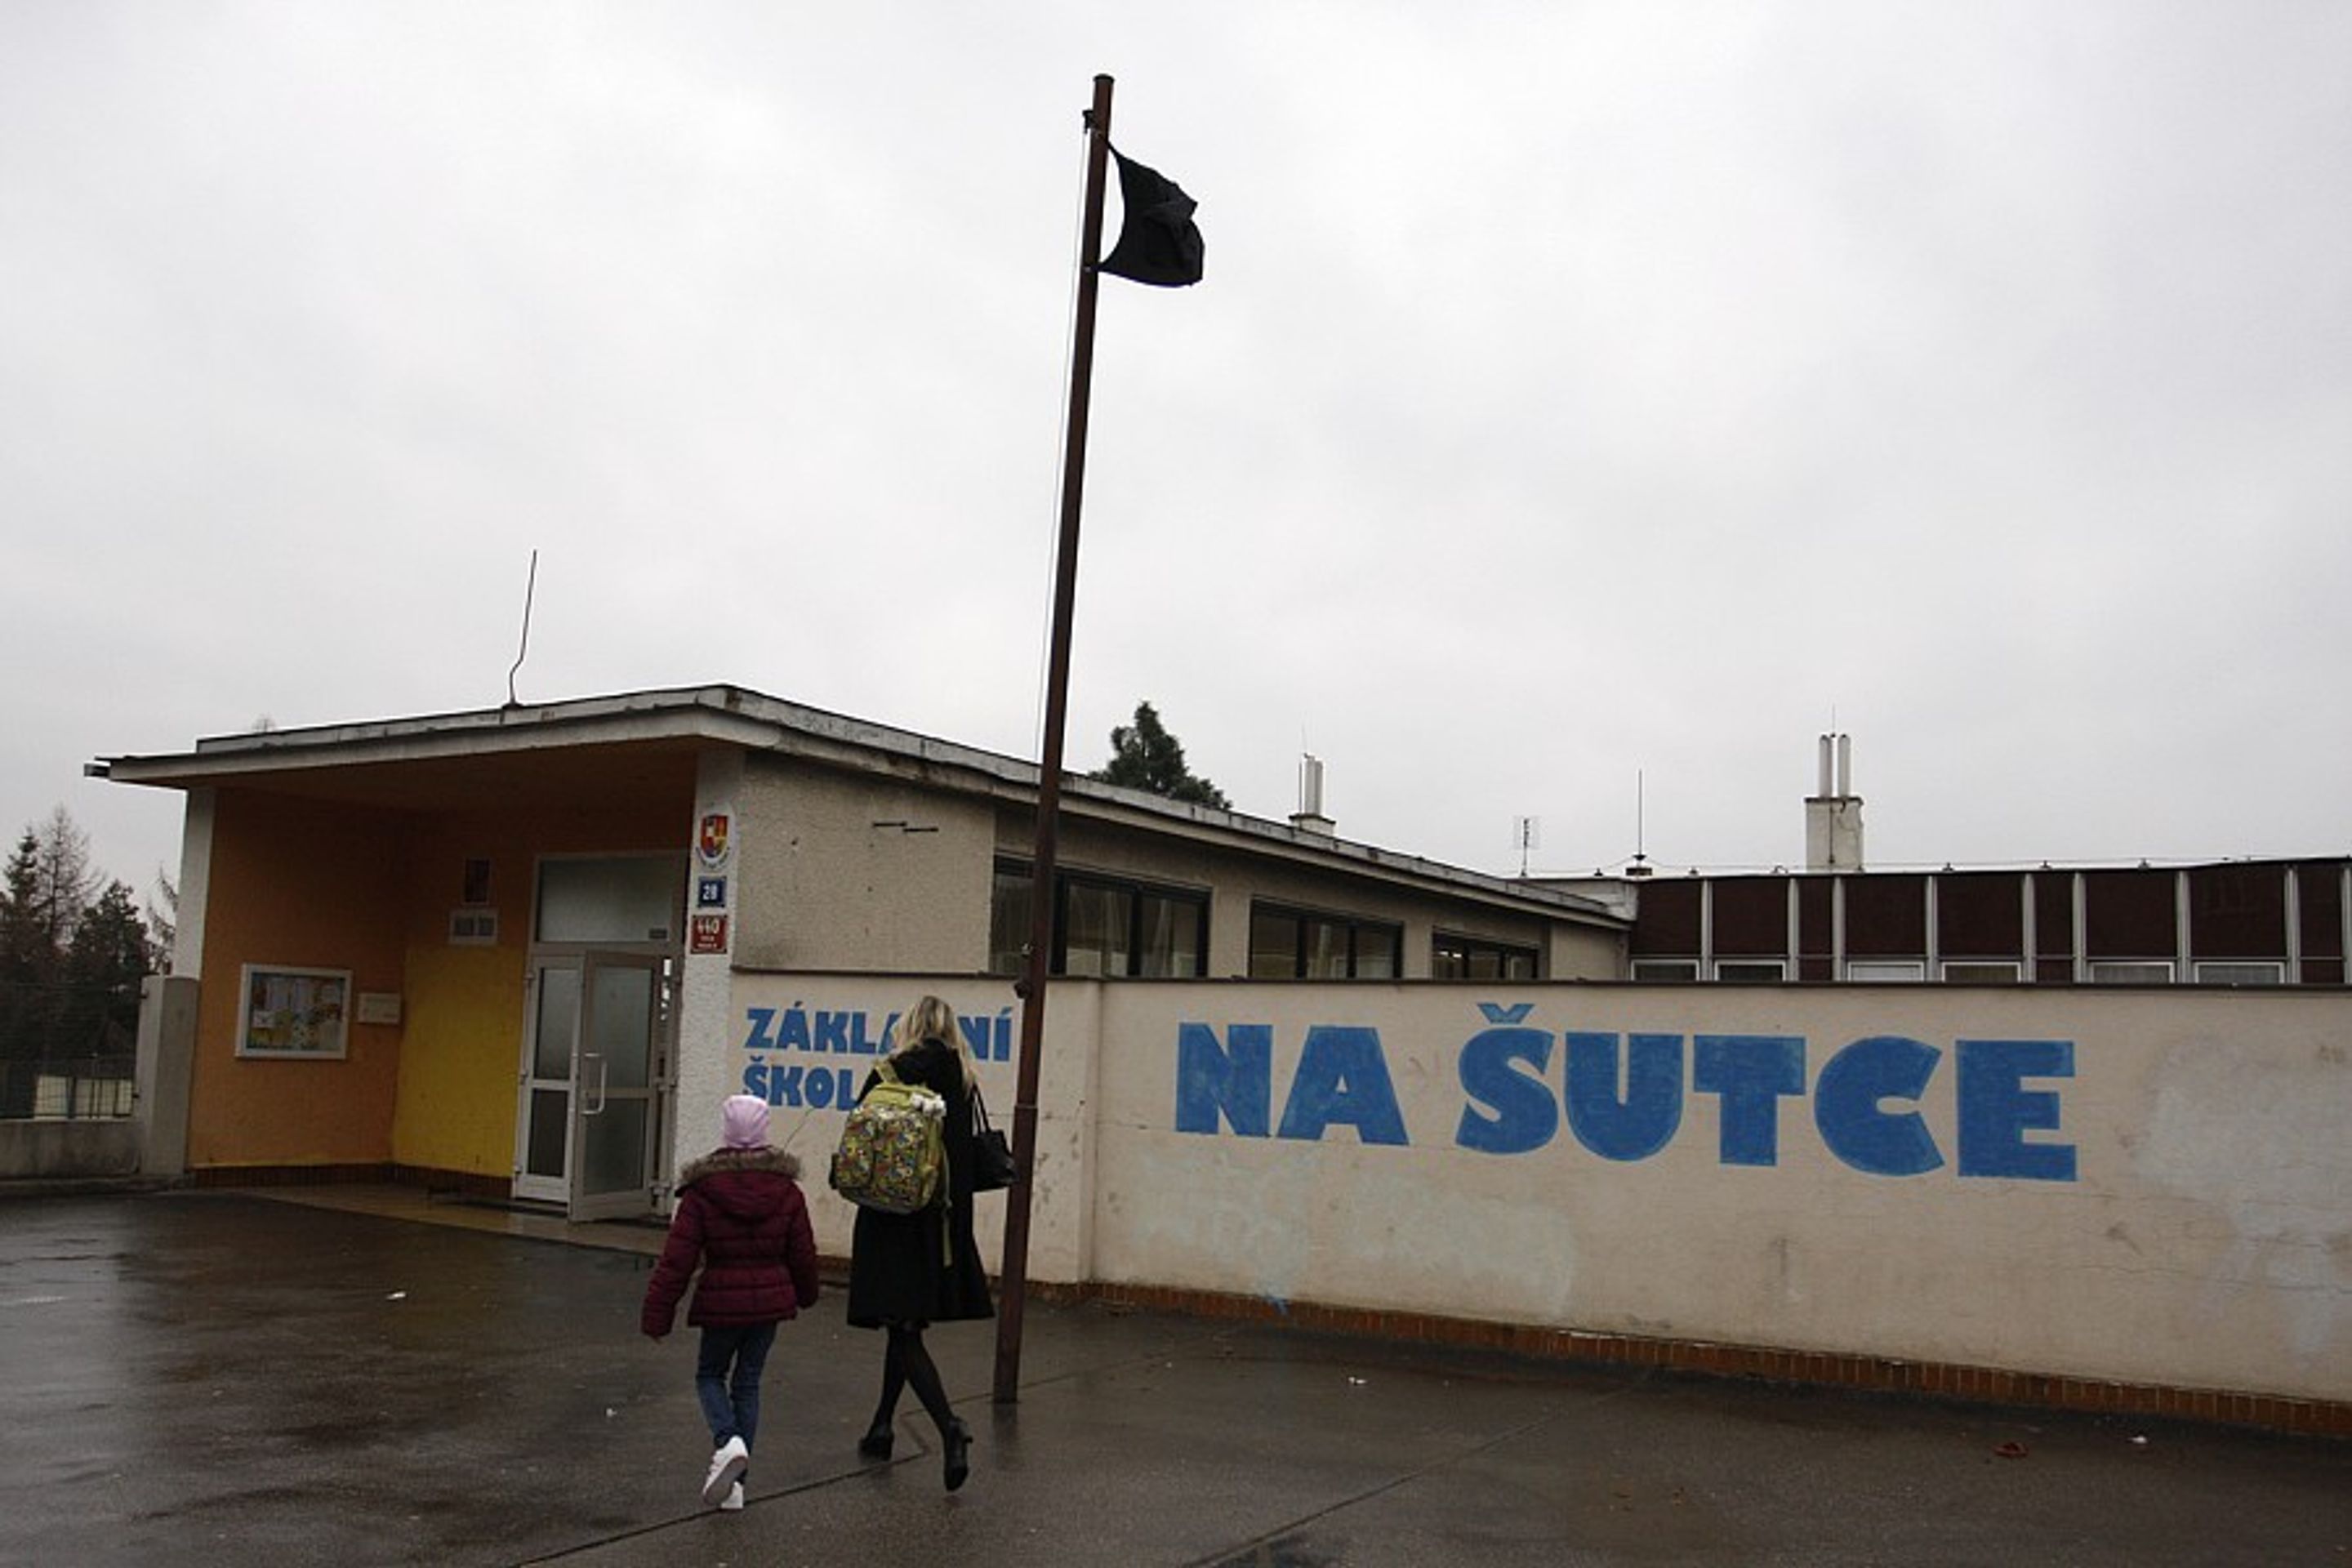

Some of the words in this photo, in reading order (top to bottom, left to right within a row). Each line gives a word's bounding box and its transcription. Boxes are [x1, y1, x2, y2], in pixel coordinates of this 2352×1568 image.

[745, 1001, 1013, 1062] ZÁKLNÍ
[742, 1055, 860, 1111] ŠKOL
[1175, 1022, 1410, 1146] NA
[1455, 1002, 2078, 1183] ŠUTCE
